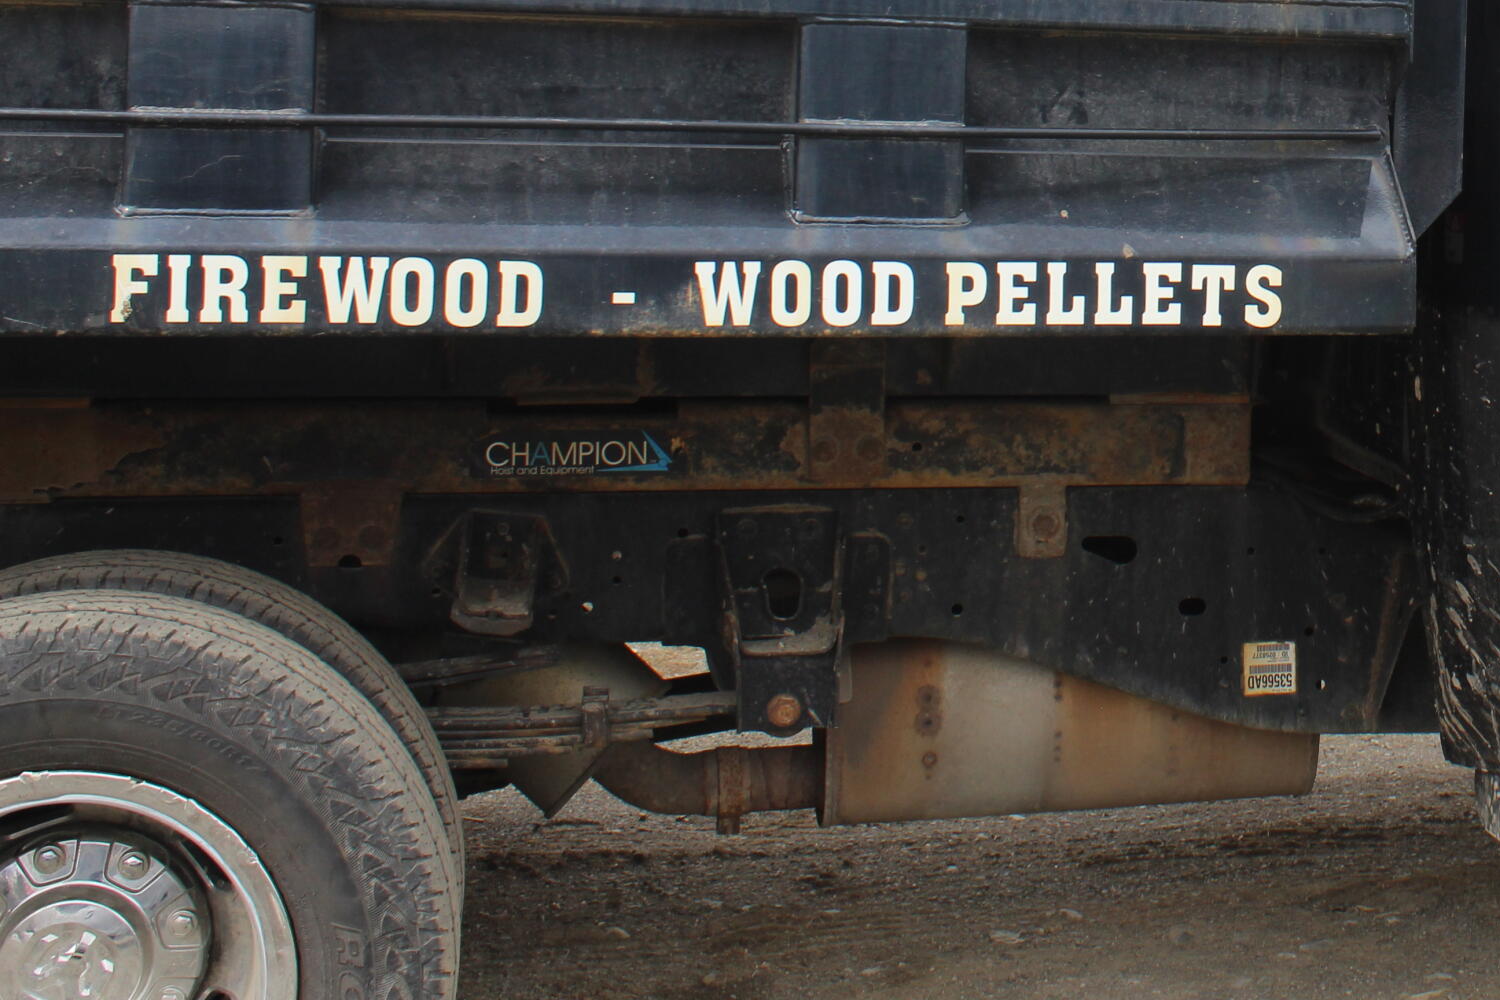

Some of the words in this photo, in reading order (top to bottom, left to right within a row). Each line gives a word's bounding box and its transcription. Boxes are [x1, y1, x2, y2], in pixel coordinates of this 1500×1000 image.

[109, 253, 545, 328] FIREWOOD
[694, 259, 916, 328] WOOD
[944, 260, 1285, 330] PELLETS
[485, 440, 648, 466] CHAMPION
[516, 466, 538, 476] and
[1247, 672, 1293, 690] 53566AD
